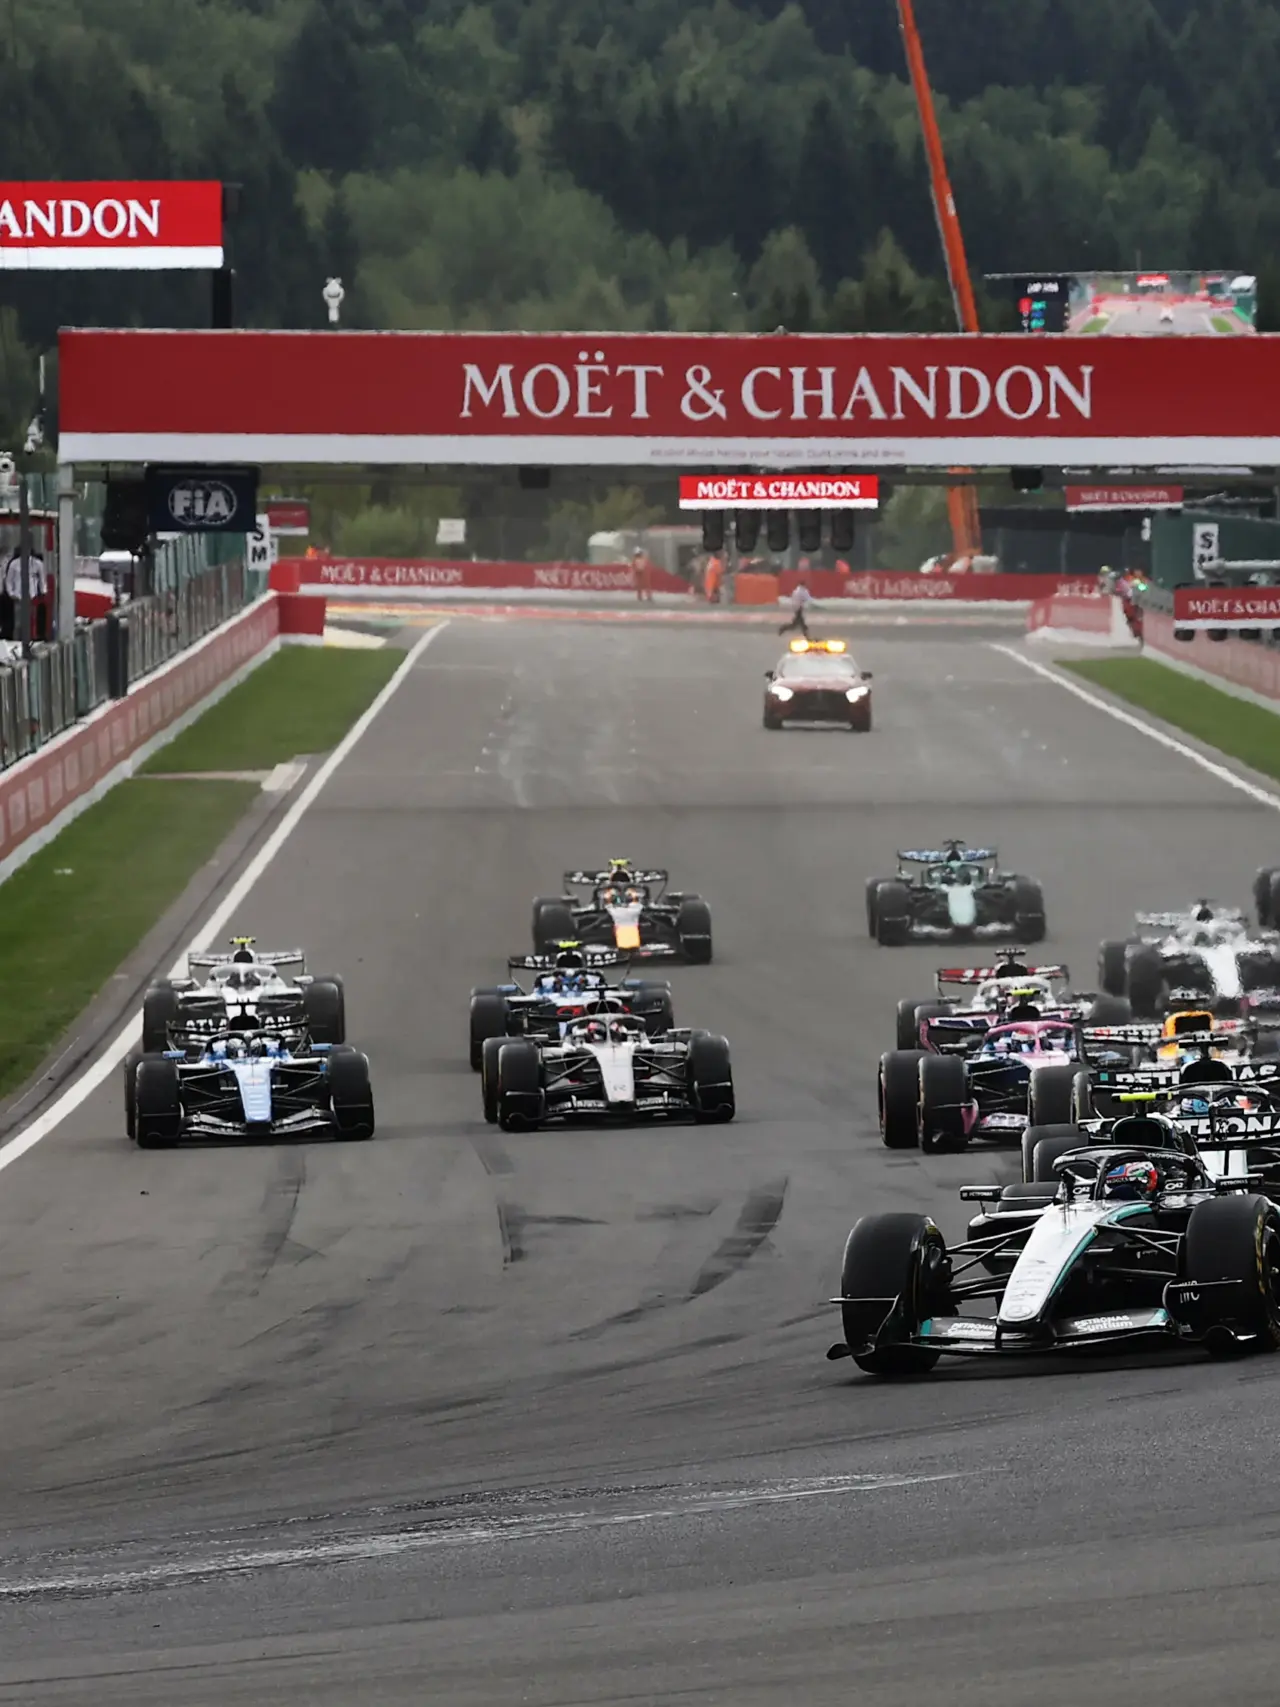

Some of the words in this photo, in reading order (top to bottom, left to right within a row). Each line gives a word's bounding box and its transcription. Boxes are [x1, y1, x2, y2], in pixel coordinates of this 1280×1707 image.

[0, 199, 160, 238] ANDON
[460, 351, 664, 419] MOËT
[680, 365, 727, 421] &
[741, 366, 1094, 419] CHANDON
[697, 478, 751, 498] MOËT
[752, 481, 768, 497] &
[768, 481, 861, 498] CHANDON
[1200, 531, 1214, 550] S
[251, 546, 268, 563] M
[1074, 1315, 1130, 1327] PETRONAS
